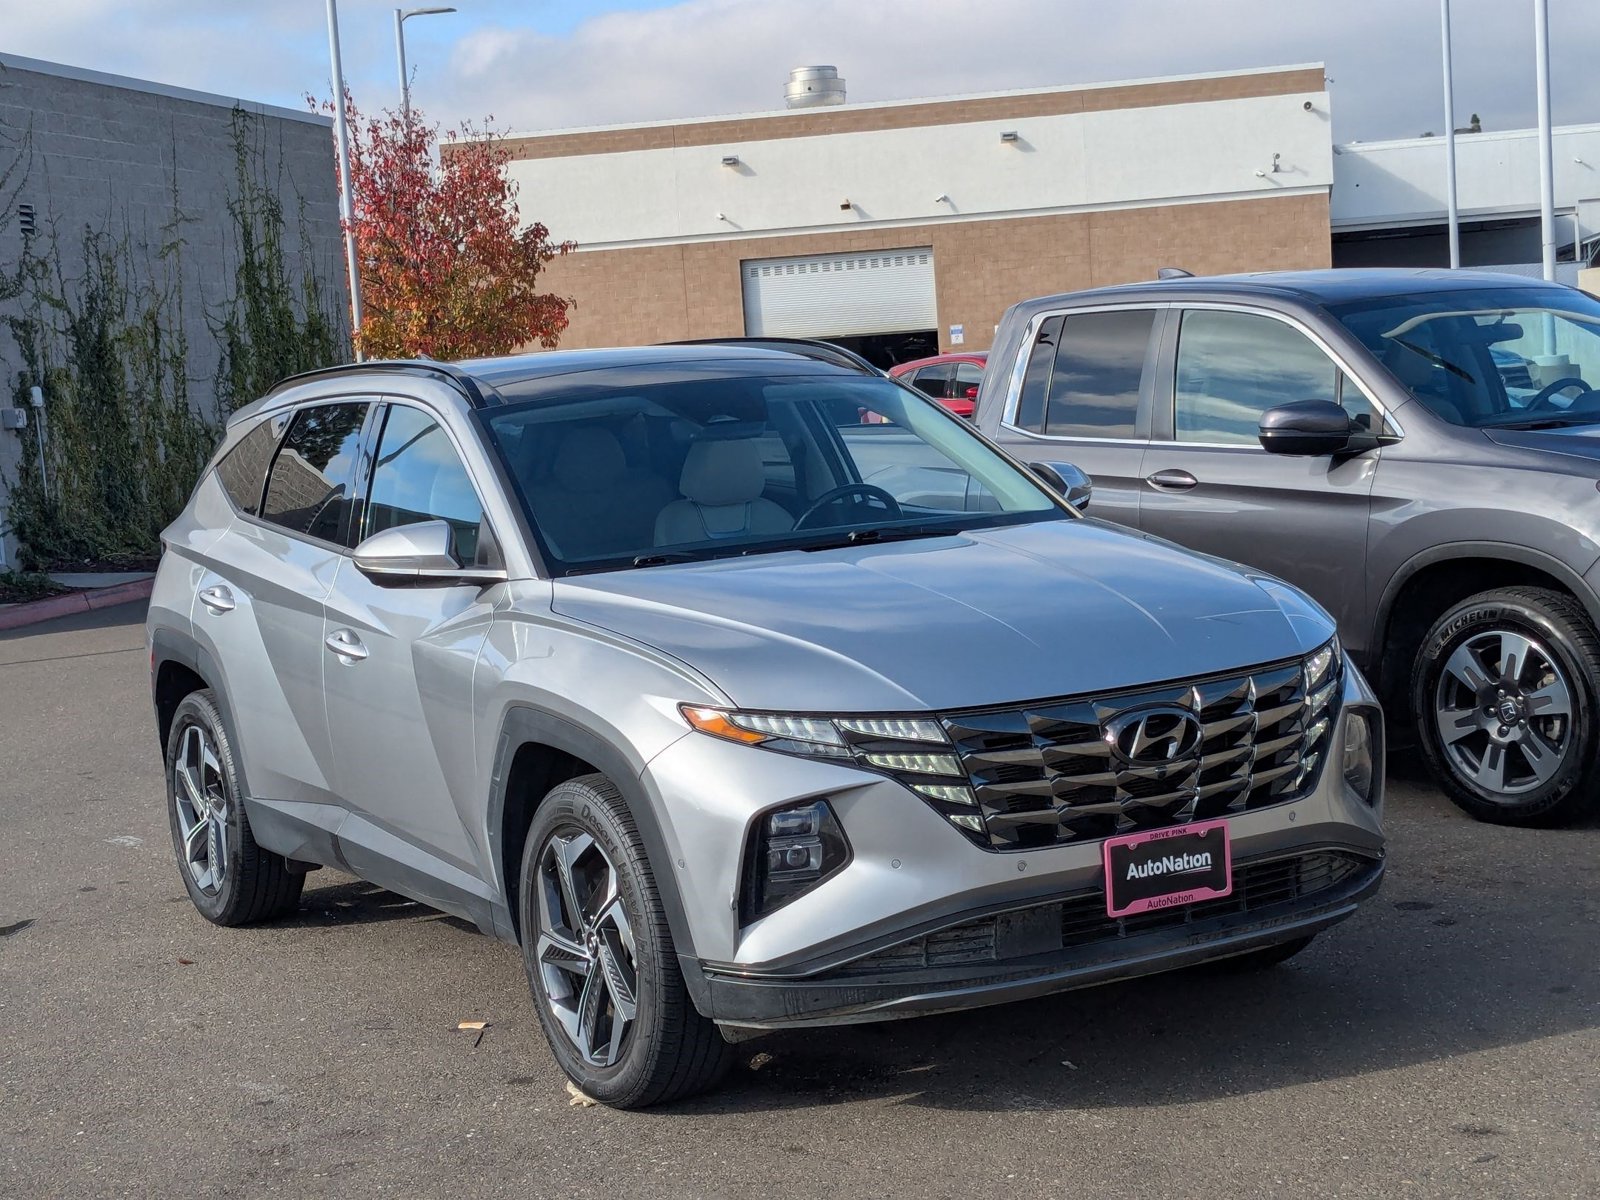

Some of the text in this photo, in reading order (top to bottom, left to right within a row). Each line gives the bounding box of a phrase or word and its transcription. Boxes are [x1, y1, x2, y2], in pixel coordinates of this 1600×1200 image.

[1440, 608, 1499, 642] MICHELIN
[581, 804, 618, 855] Desert
[1149, 828, 1187, 840] DRIVE PINK
[1126, 852, 1212, 880] AutoNation
[1146, 893, 1194, 909] AutoNation
